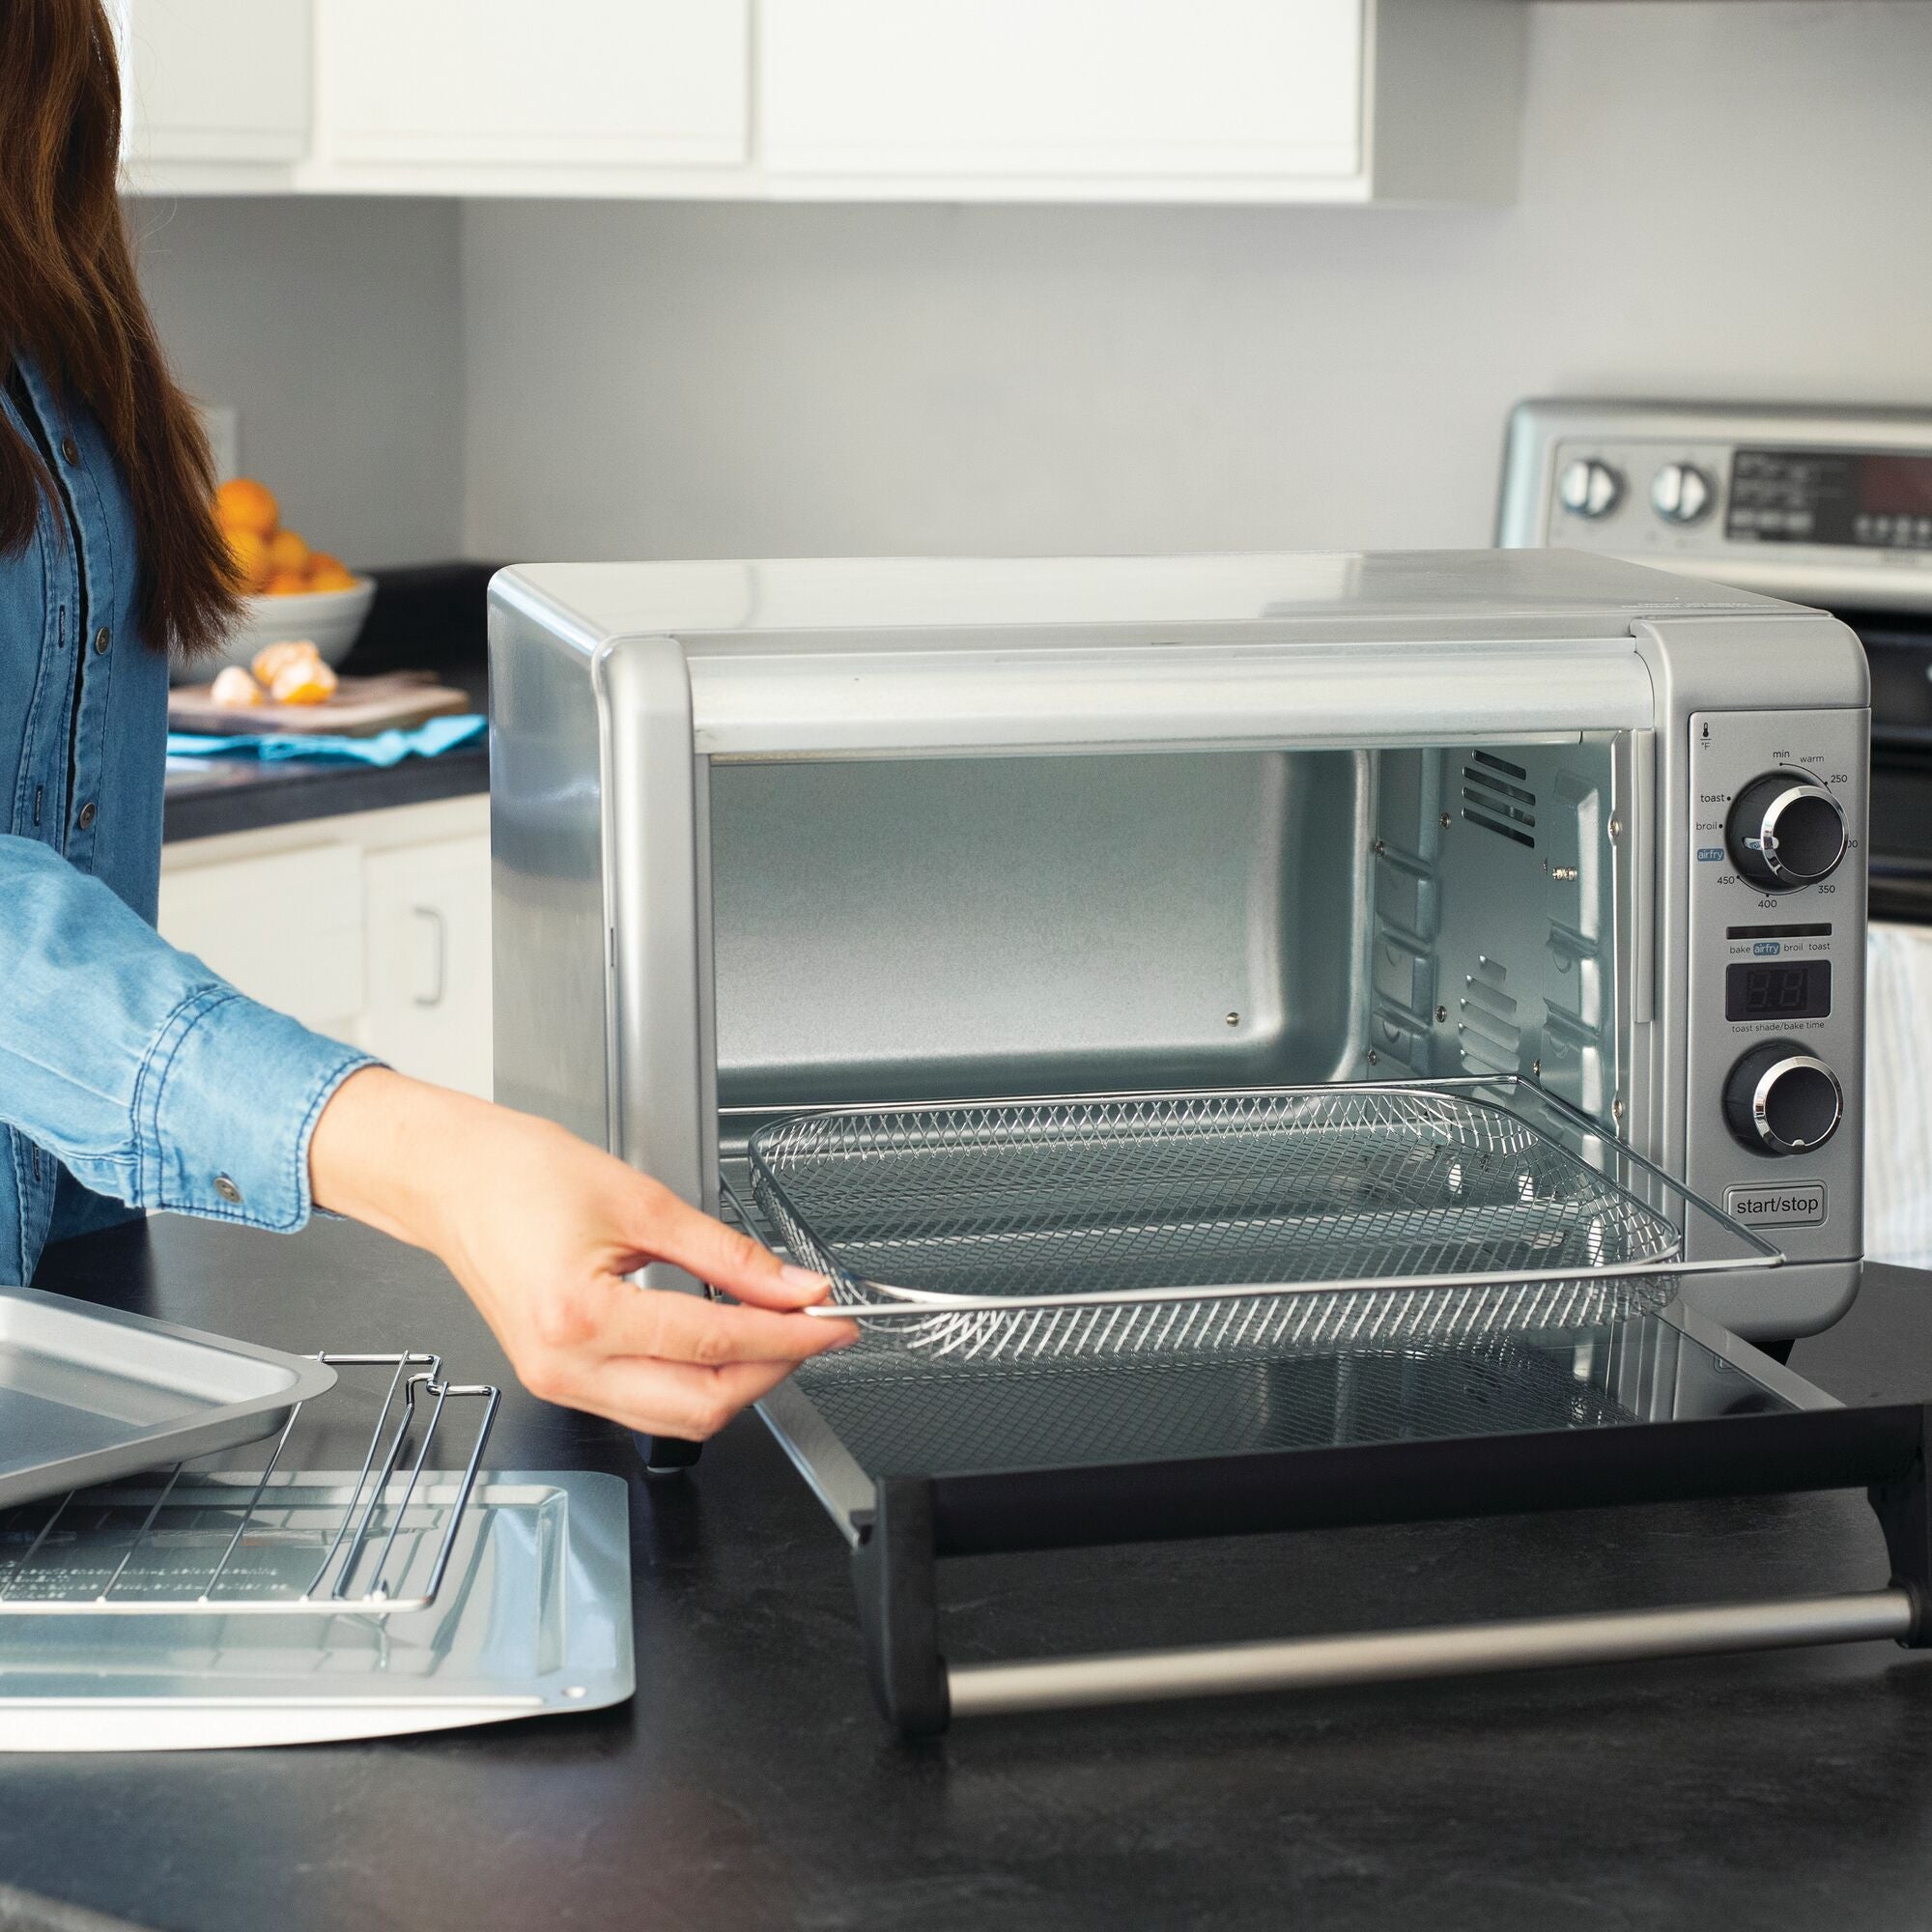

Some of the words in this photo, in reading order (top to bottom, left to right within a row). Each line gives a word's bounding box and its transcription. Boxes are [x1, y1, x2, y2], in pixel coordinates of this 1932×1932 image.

[1773, 750, 1790, 759] min
[1800, 754, 1825, 764] warm
[1831, 774, 1848, 783] 250
[1700, 793, 1725, 803] toast
[1696, 821, 1718, 831] broil
[1697, 849, 1724, 861] airfry
[1717, 875, 1735, 885] 450
[1818, 885, 1835, 895] 350
[1757, 899, 1777, 909] 400
[1729, 945, 1751, 954] bake
[1754, 942, 1779, 954] airfry
[1783, 943, 1804, 952] broil
[1808, 942, 1831, 951] toast
[1755, 1020, 1804, 1032] shade/bake
[1805, 1021, 1825, 1030] time
[1736, 1196, 1819, 1214] start/stop
